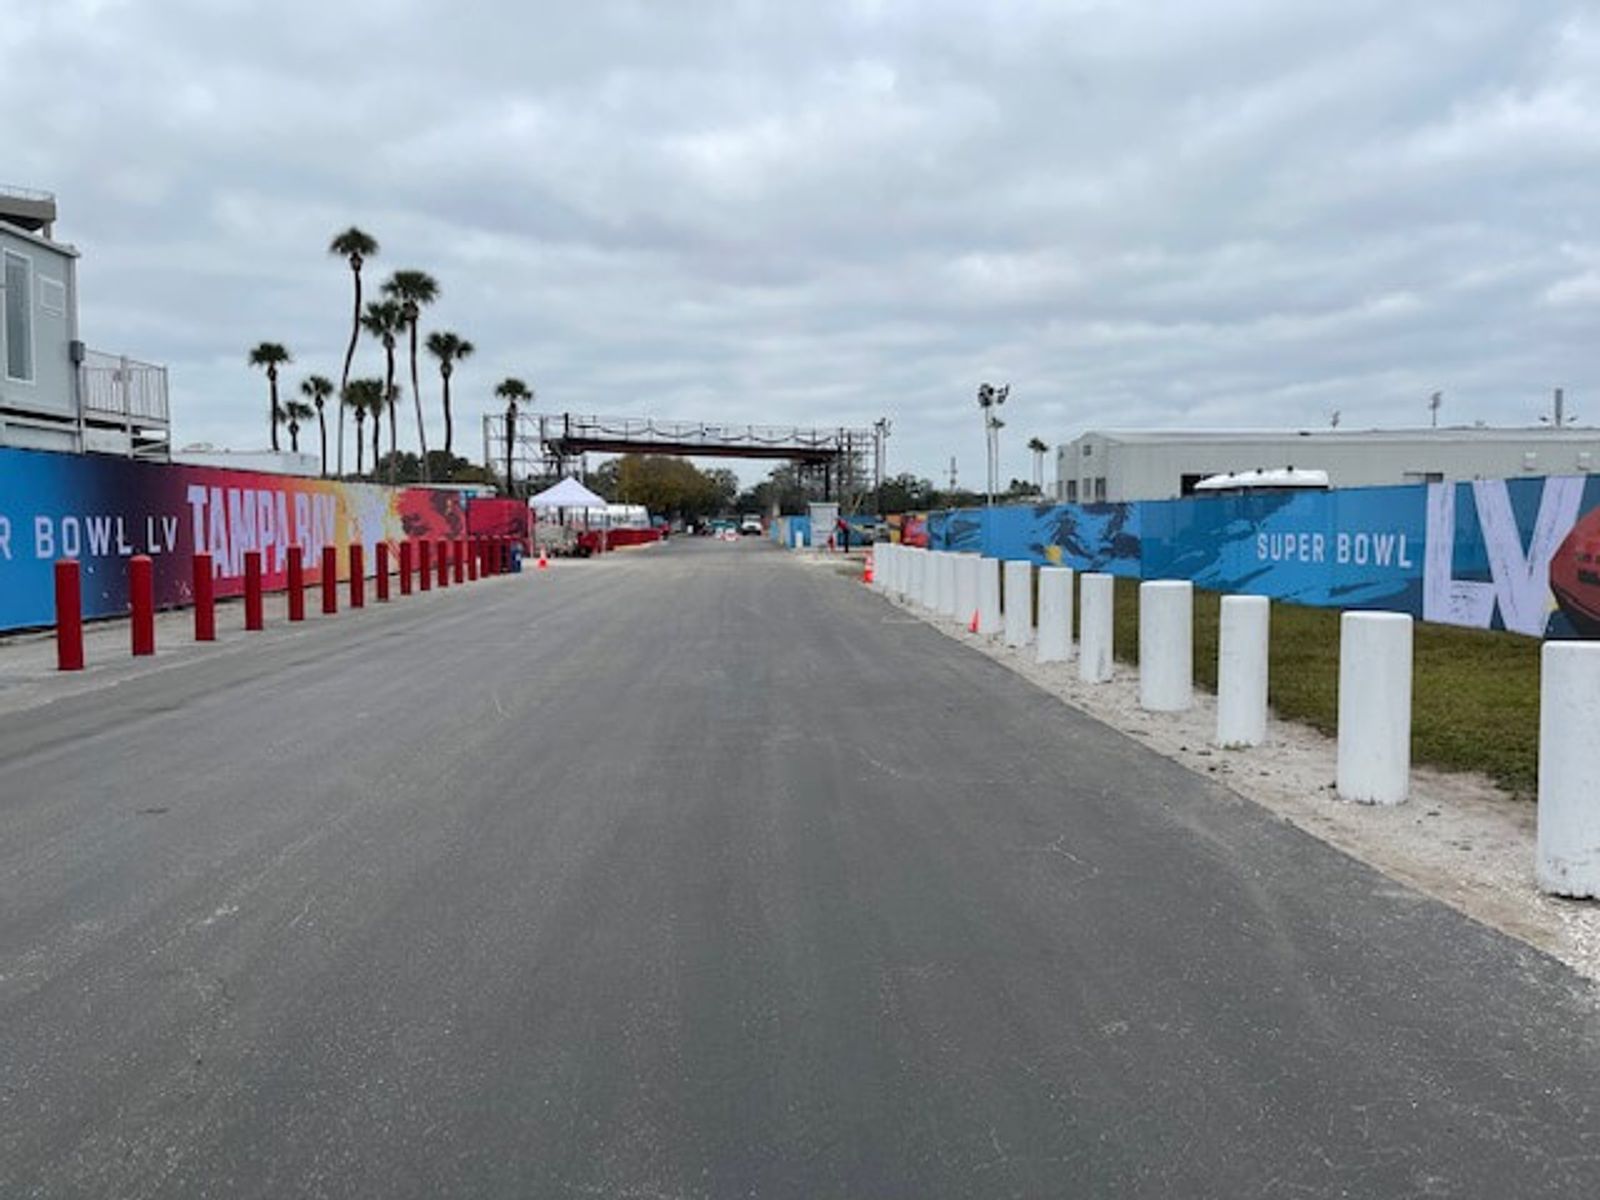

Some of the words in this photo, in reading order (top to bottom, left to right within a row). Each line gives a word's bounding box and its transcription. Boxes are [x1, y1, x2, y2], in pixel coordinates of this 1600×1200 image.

[35, 515, 133, 559] BOWL
[147, 516, 177, 552] LV
[187, 485, 289, 578] TAMPA
[1257, 532, 1324, 563] SUPER
[1337, 532, 1413, 568] BOWL
[1423, 476, 1587, 638] LV
